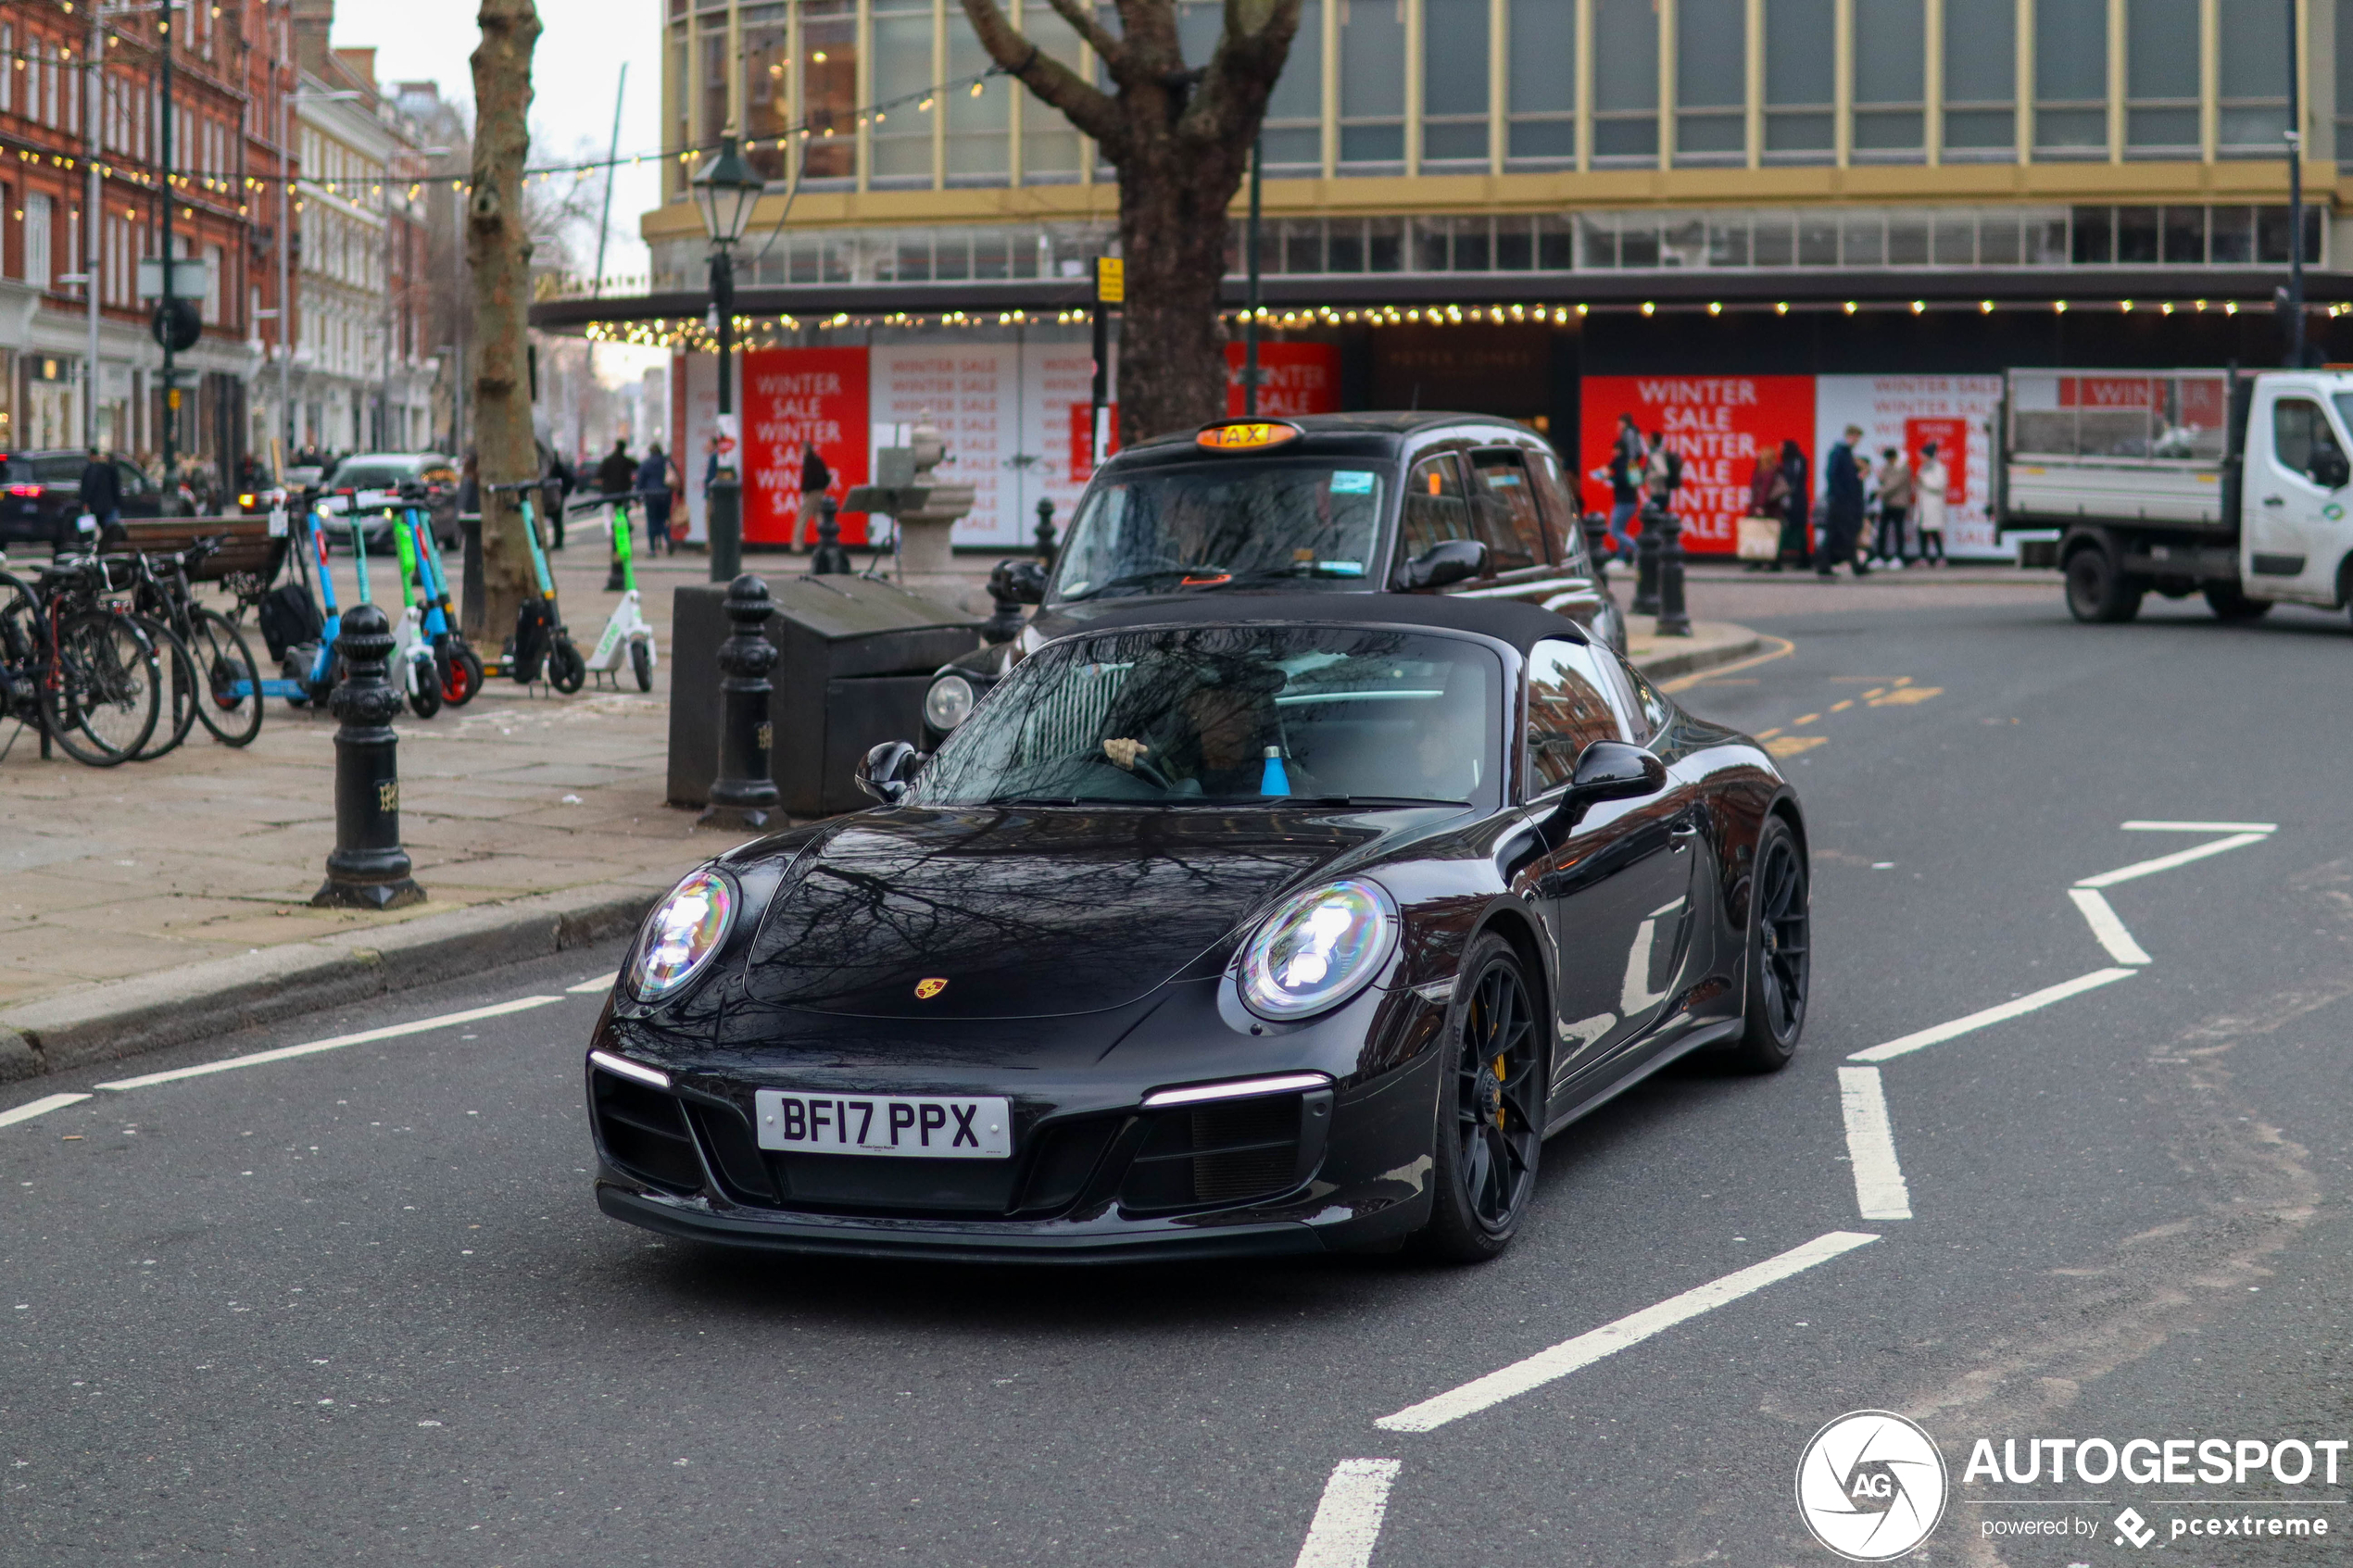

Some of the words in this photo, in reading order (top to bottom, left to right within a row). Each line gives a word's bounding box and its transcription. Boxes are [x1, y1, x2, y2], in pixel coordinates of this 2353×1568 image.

[755, 372, 842, 395] WINTER
[1638, 379, 1757, 405] WINTER
[772, 396, 822, 420] SALE
[1663, 406, 1731, 432] SALE
[755, 420, 842, 443] WINTER
[1214, 425, 1272, 445] TAXI
[755, 468, 842, 490] WINR
[1680, 458, 1731, 484] ALE
[772, 491, 805, 514] SA
[1680, 512, 1731, 539] ALE
[781, 1098, 874, 1144] BF17
[888, 1102, 979, 1148] PPX
